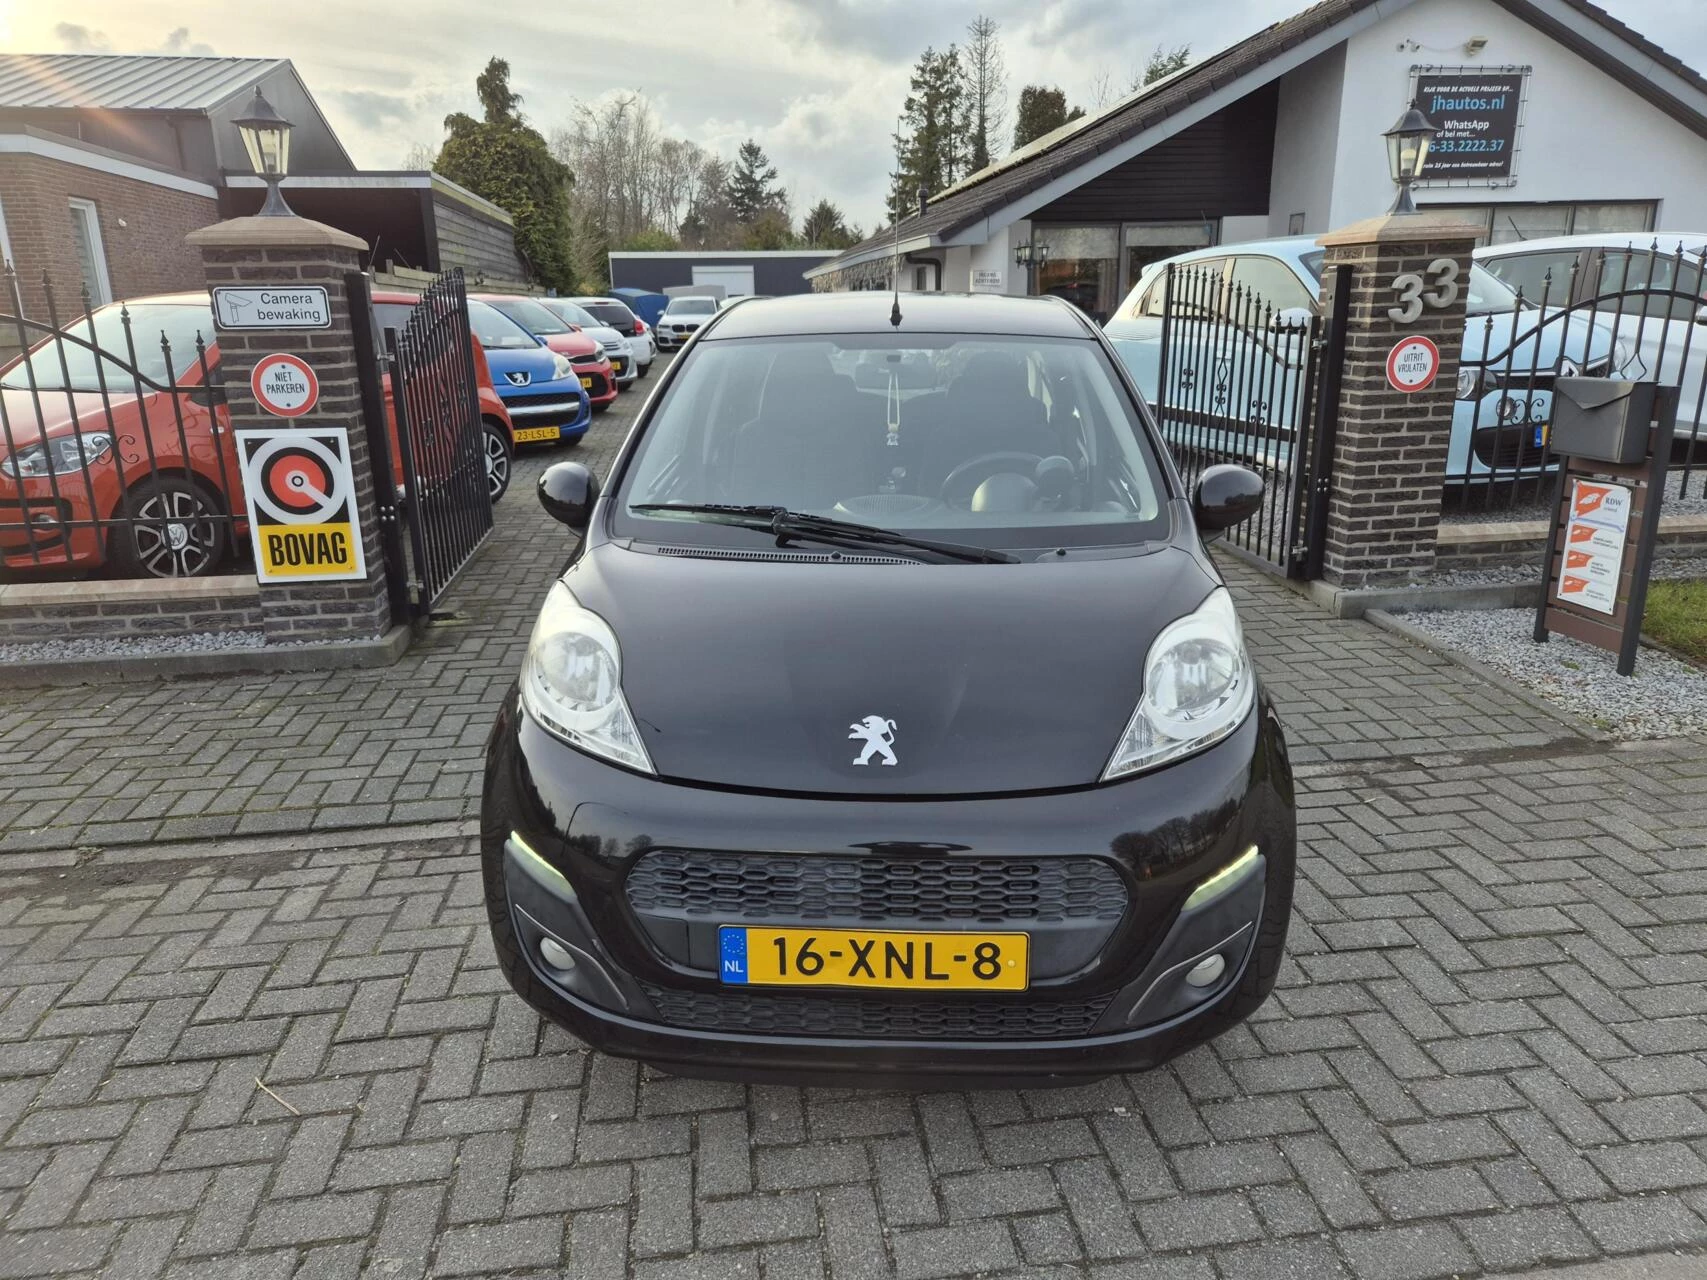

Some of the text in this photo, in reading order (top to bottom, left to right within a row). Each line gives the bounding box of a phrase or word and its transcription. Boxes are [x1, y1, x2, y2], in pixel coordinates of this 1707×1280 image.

[1430, 94, 1505, 114] jhautos.nl
[1444, 119, 1490, 131] WhatsApp
[1436, 130, 1444, 138] of
[1444, 130, 1456, 138] bel
[1428, 139, 1505, 152] 6-33.2222.37
[1388, 258, 1460, 324] 33
[260, 292, 313, 305] Camera
[257, 309, 321, 322] bewaking
[1403, 352, 1424, 362] UITRIT
[1398, 362, 1428, 373] VRIJLATEN
[274, 371, 293, 382] NIET
[266, 383, 306, 394] PARKEREN
[517, 428, 556, 441] 23-LSL-5
[1605, 496, 1623, 506] RDW
[268, 532, 348, 566] BOVAG
[773, 936, 1002, 981] 16-XNL-8
[724, 960, 744, 974] NL
